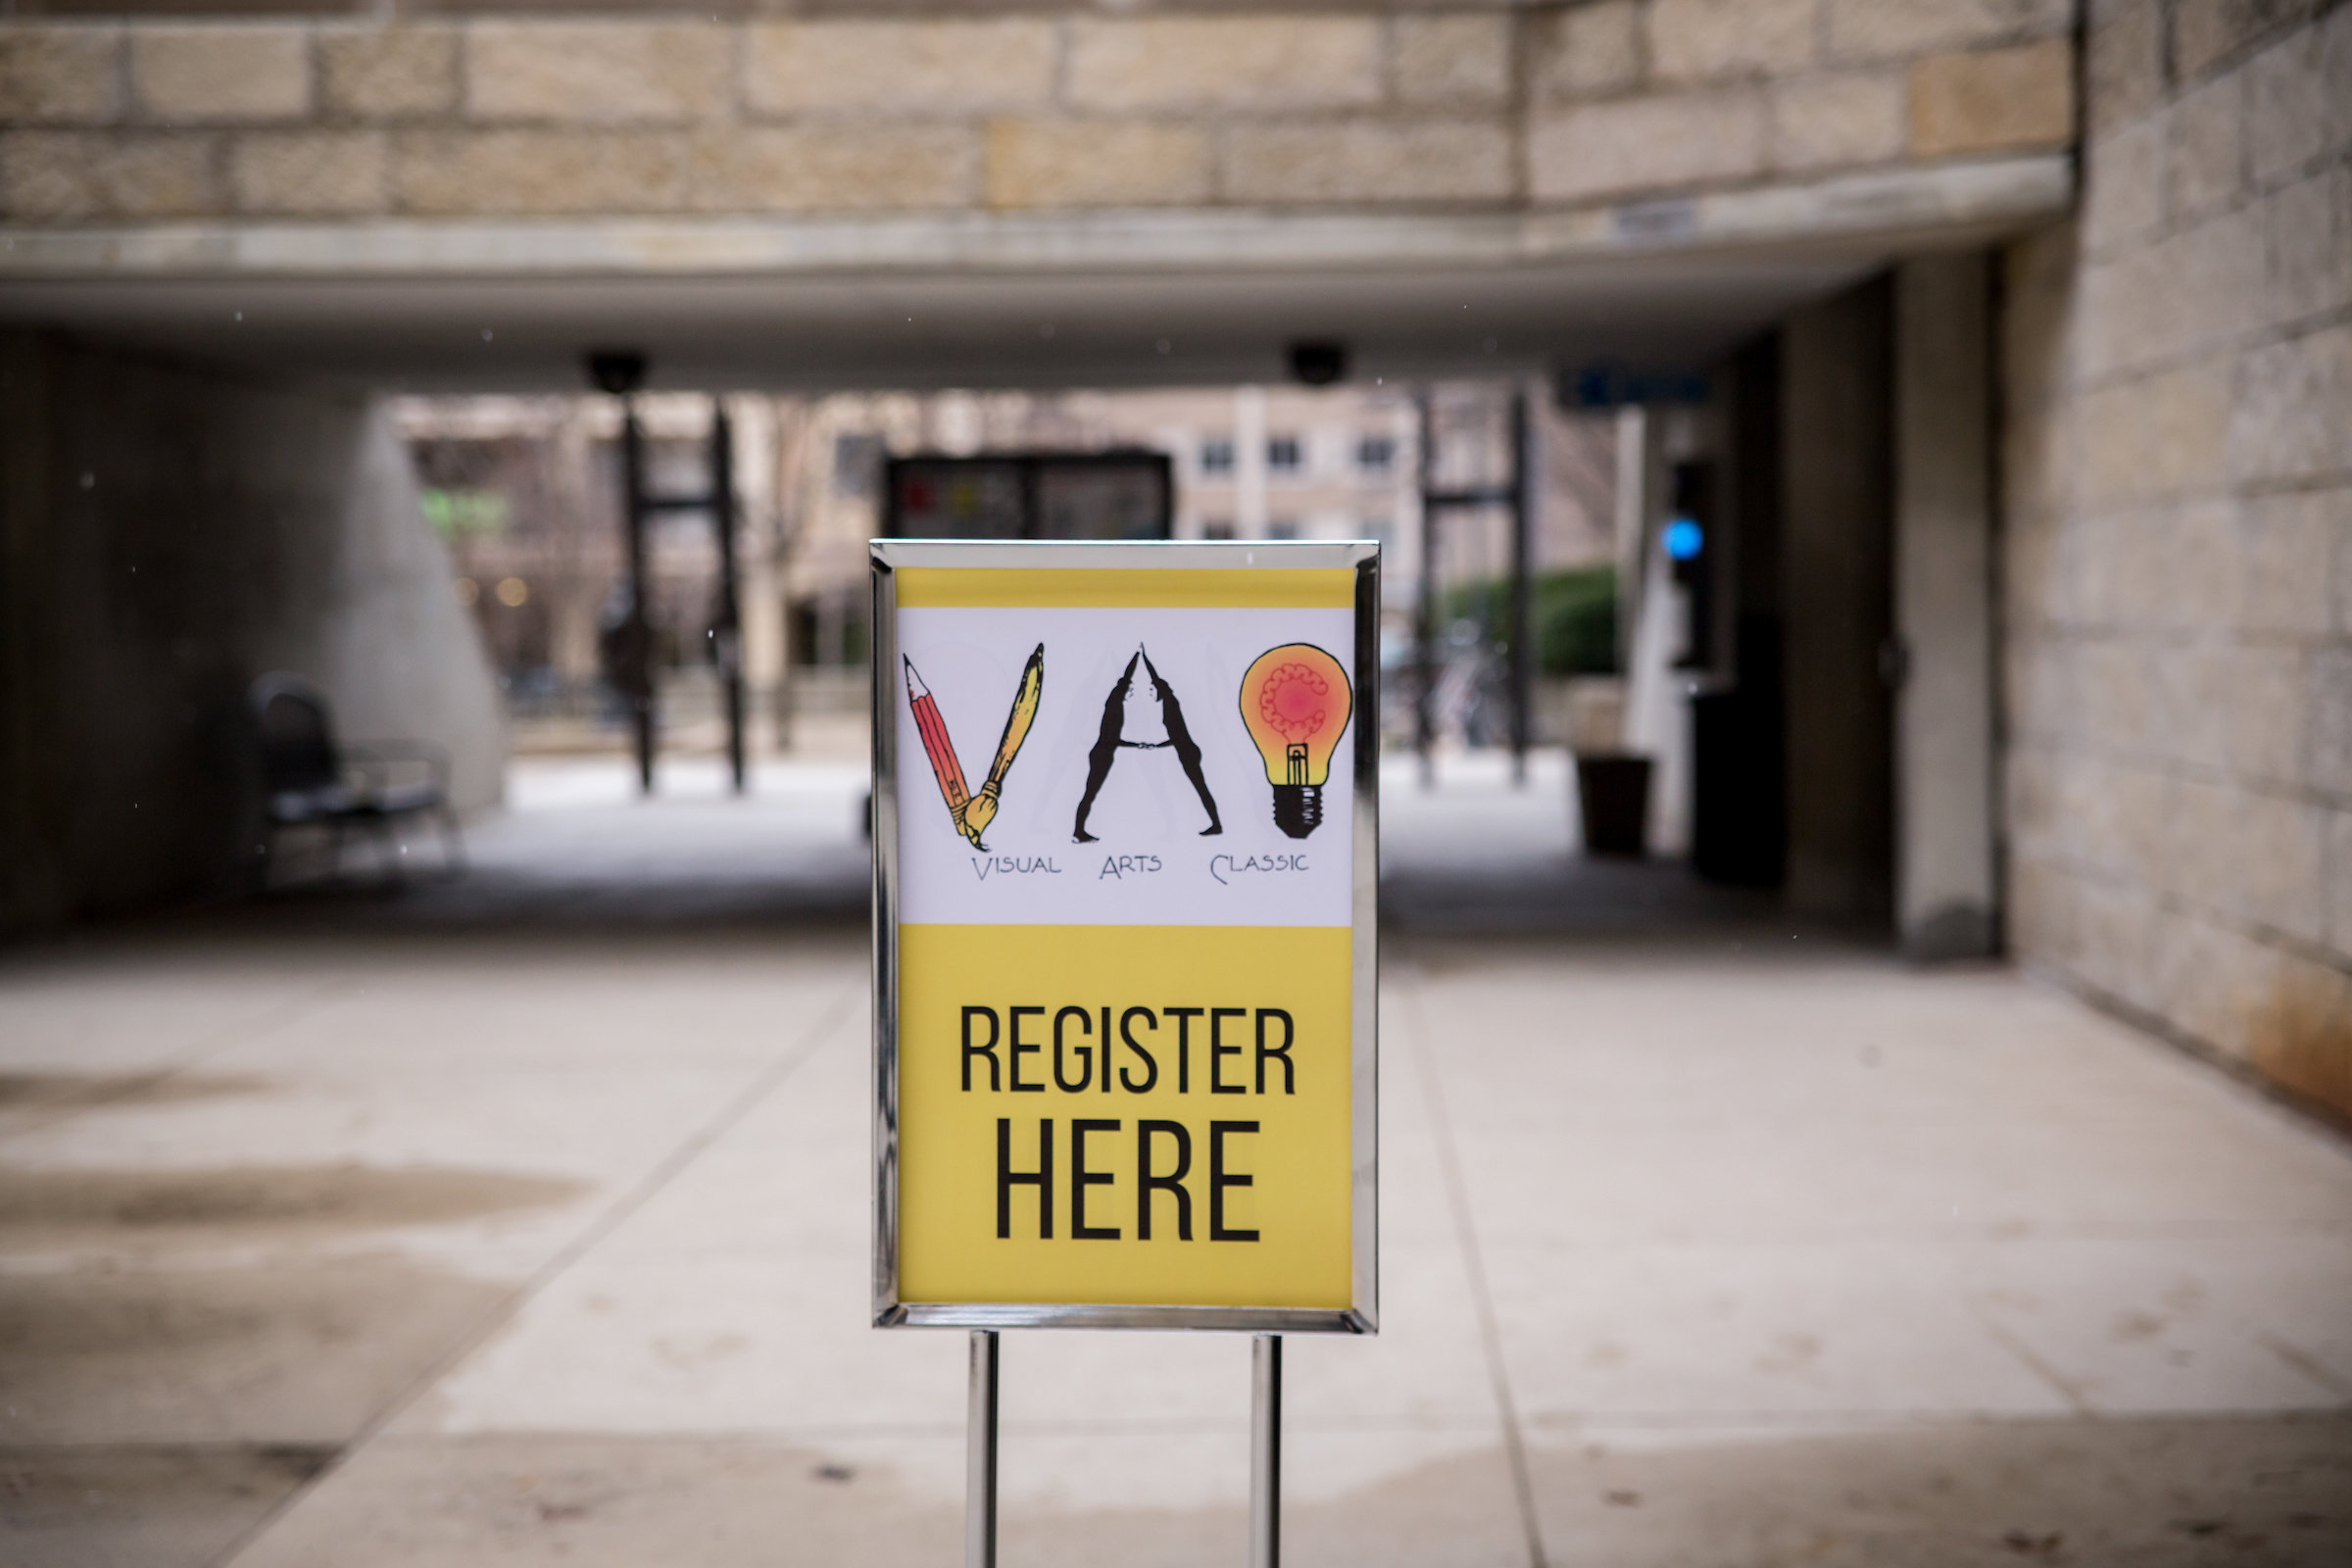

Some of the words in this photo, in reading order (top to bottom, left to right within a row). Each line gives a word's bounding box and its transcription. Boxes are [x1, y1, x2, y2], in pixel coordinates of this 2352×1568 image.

[970, 857, 1062, 881] VISUAL
[1099, 855, 1162, 880] ARTS
[1209, 854, 1310, 886] CLASSIC
[960, 1004, 1296, 1096] REGISTER
[997, 1117, 1260, 1243] HERE
